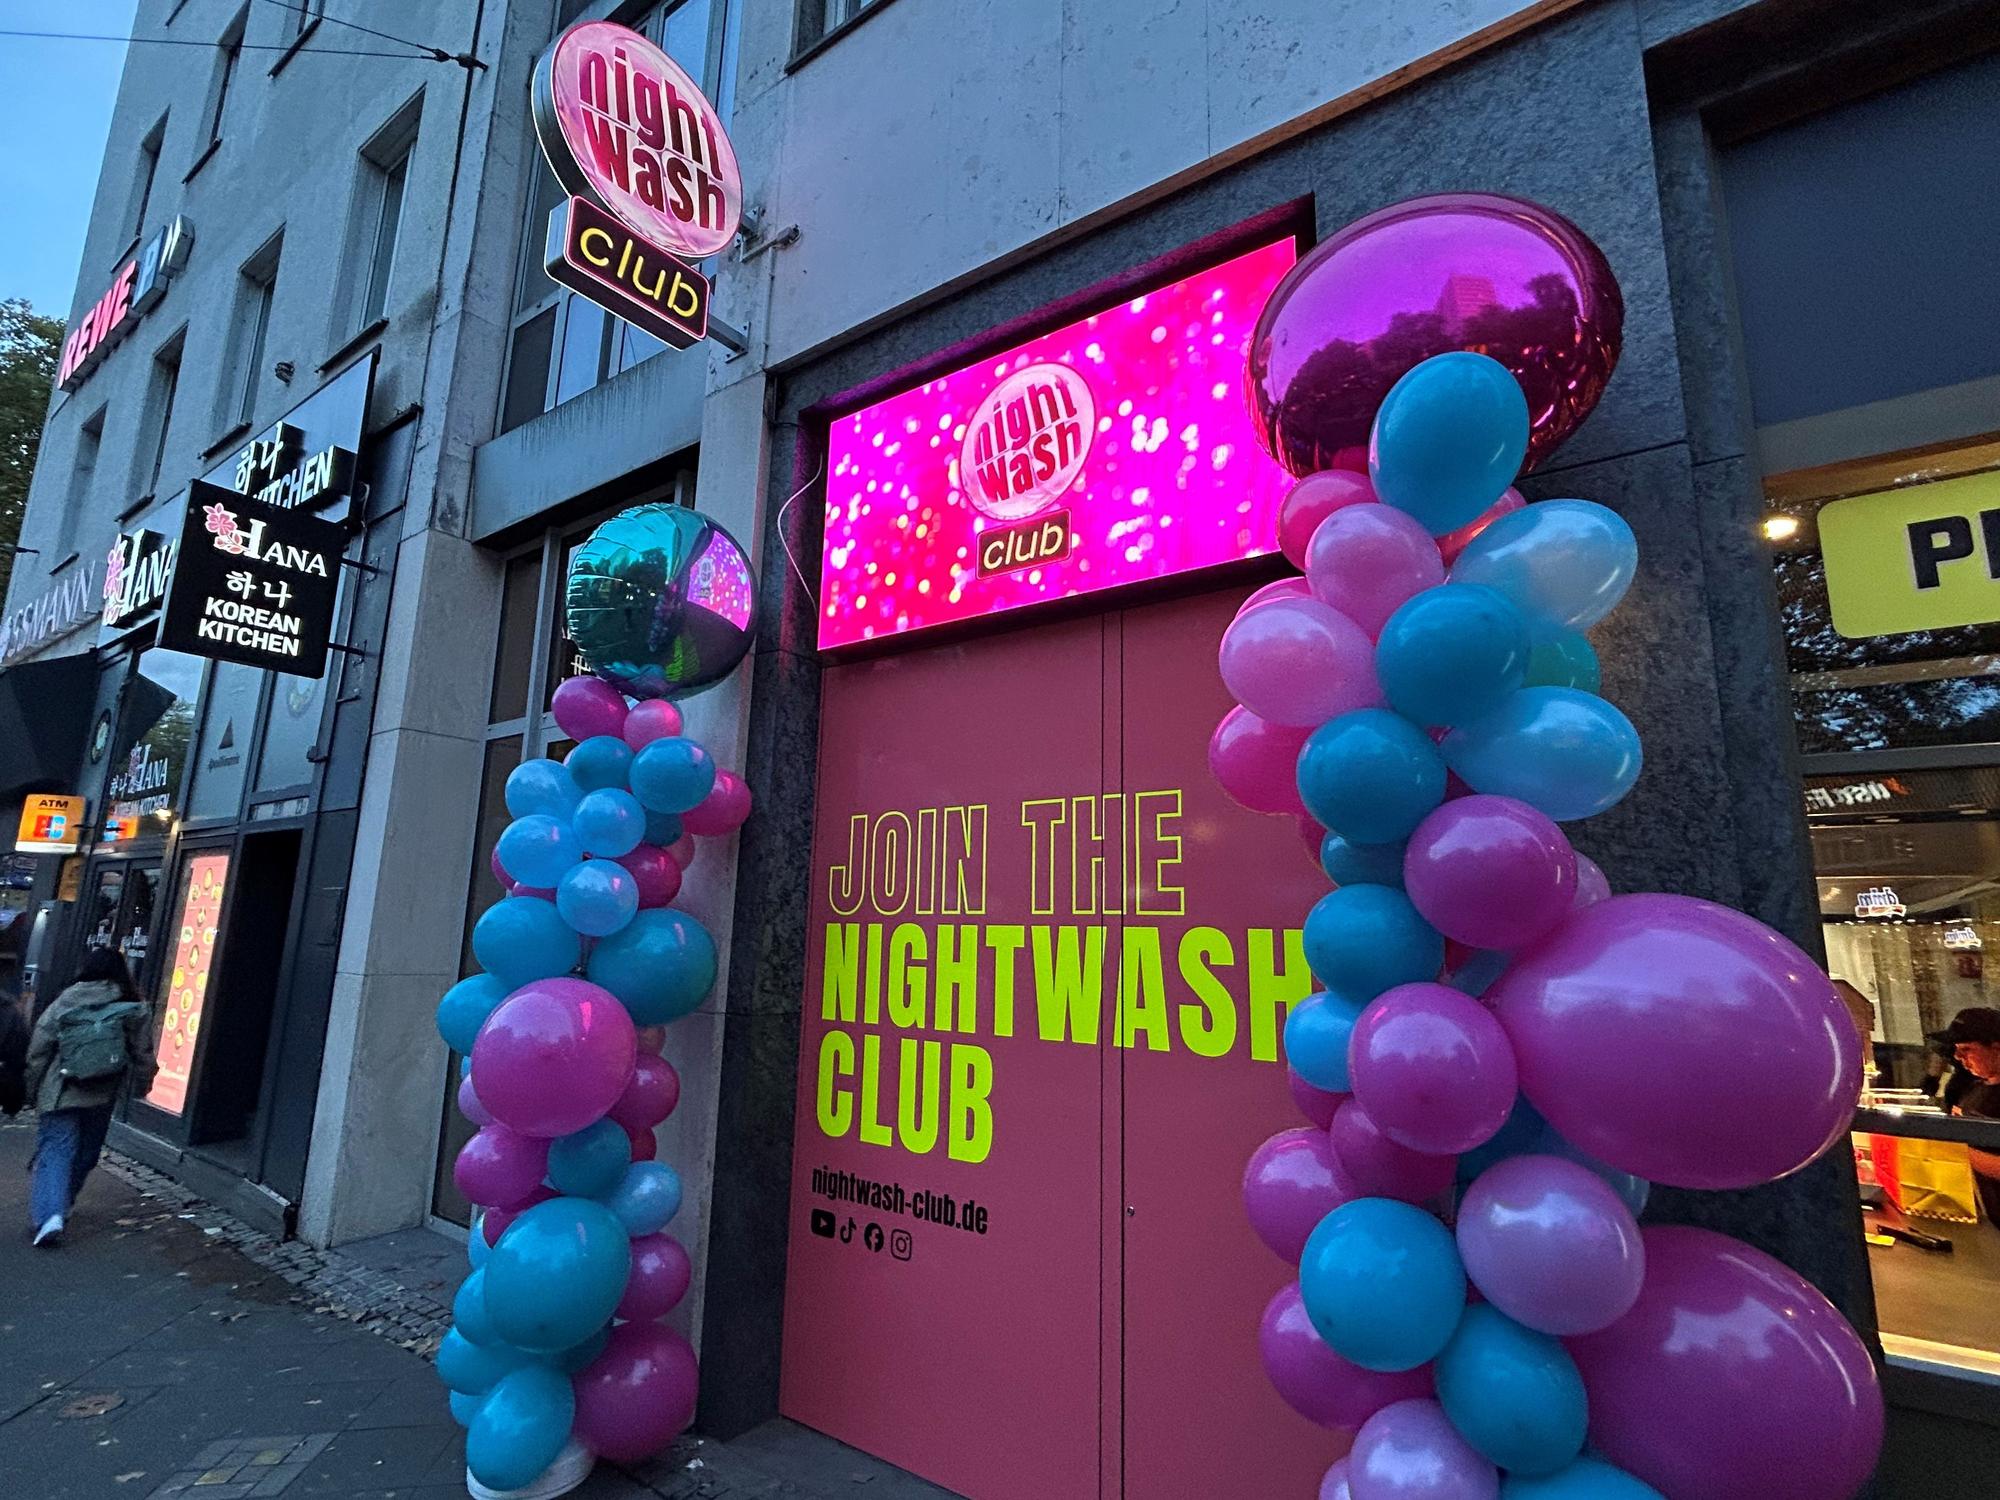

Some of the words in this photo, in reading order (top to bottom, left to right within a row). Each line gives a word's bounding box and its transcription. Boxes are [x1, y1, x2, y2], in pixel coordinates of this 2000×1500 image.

[579, 46, 724, 182] night
[580, 107, 726, 232] wash
[580, 227, 698, 318] club
[57, 259, 137, 390] REWE
[234, 420, 284, 495] 하나
[975, 374, 1078, 467] night
[253, 445, 334, 510] TCHEN
[976, 421, 1082, 502] wash
[983, 522, 1064, 570] club
[204, 597, 300, 635] KOREAN
[225, 570, 293, 608] 하나
[198, 619, 300, 657] KITCHEN
[39, 799, 69, 808] ATM
[828, 804, 988, 916] JOIN
[1021, 789, 1185, 916] THE
[821, 922, 1312, 1063] NIGHTWASH
[817, 1030, 994, 1164] CLUB
[811, 1165, 988, 1235] nightwash-club.de
